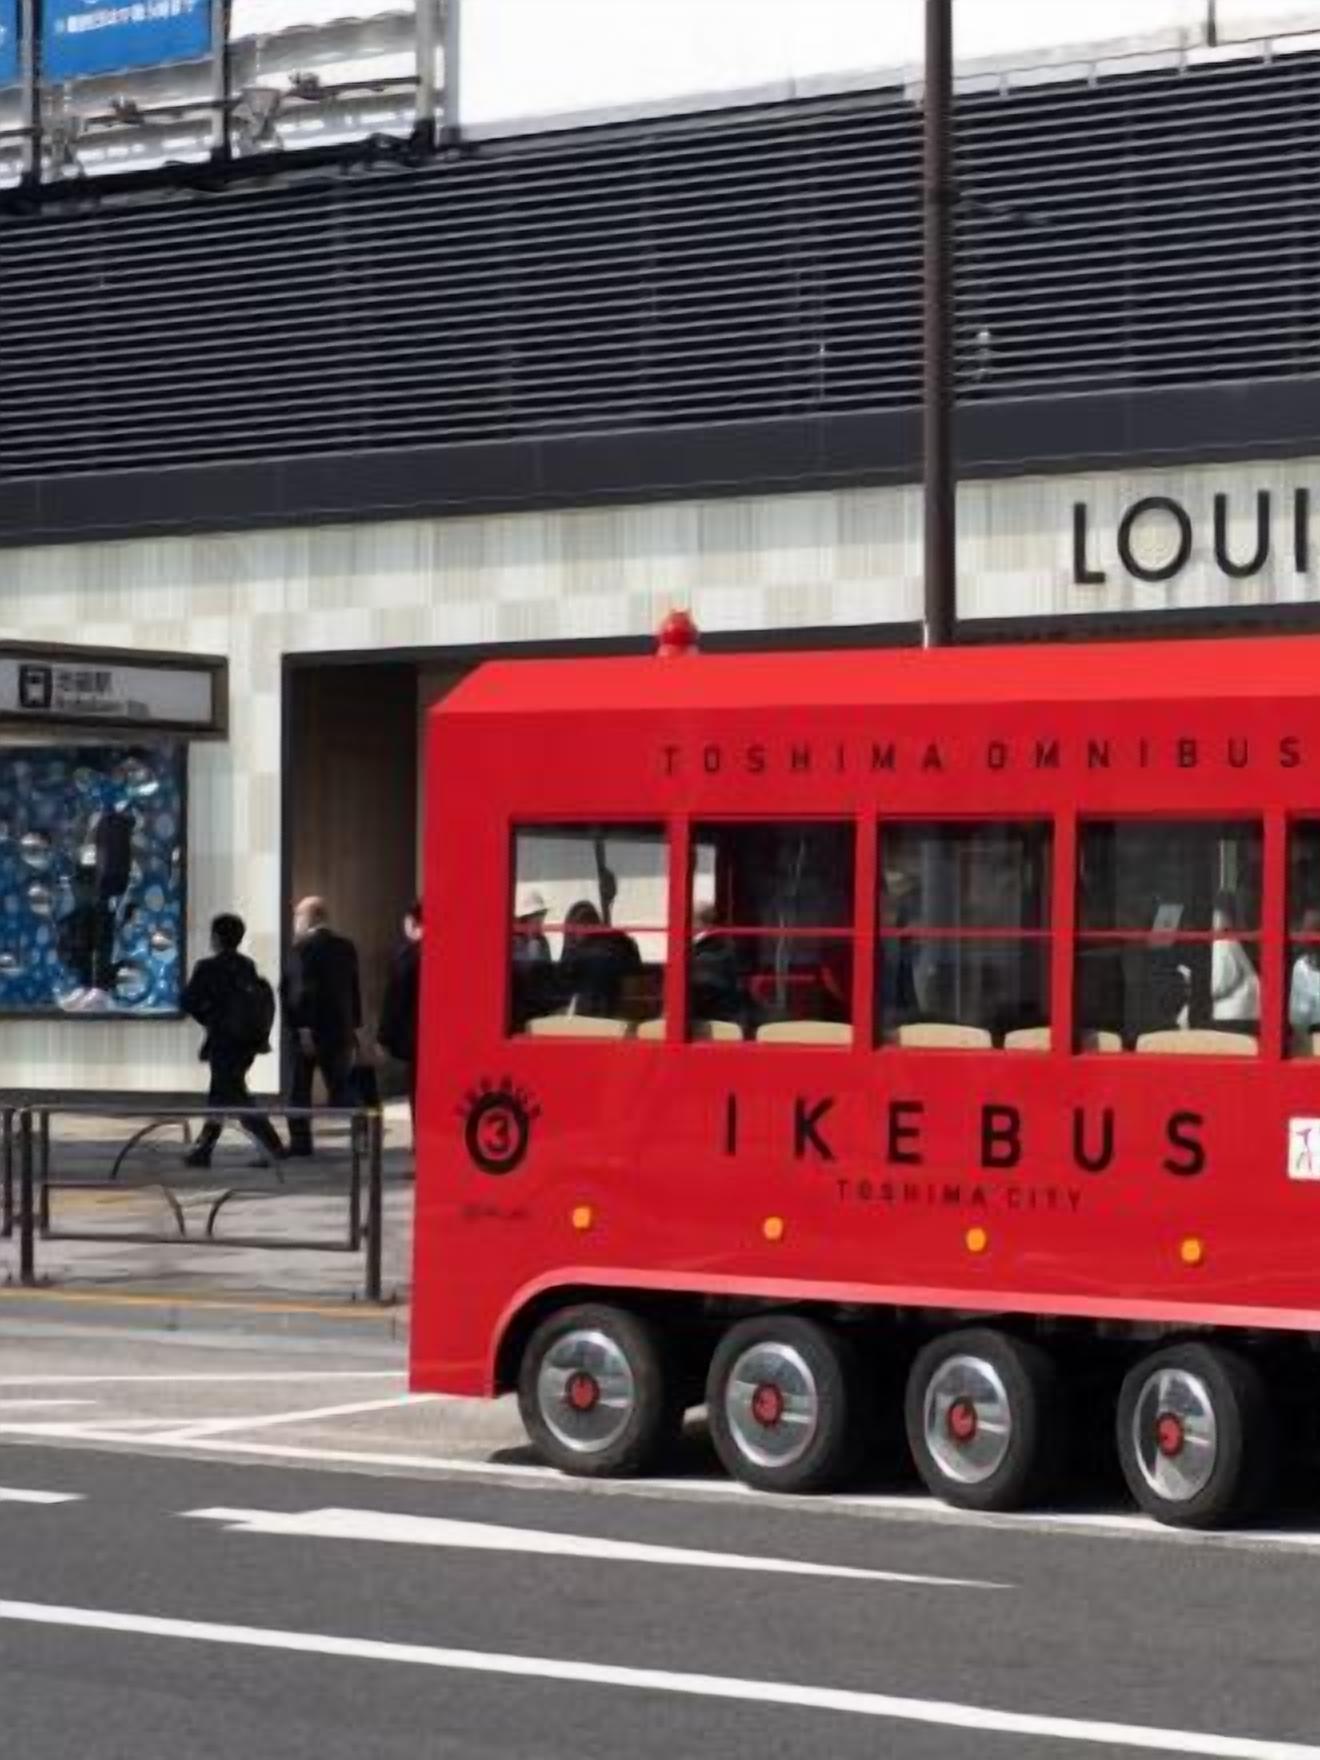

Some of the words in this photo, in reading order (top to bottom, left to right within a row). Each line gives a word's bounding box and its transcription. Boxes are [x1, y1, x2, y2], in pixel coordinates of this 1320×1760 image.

[662, 743, 944, 775] TOSHIMA
[986, 736, 1302, 771] OMNIBUS
[484, 1112, 512, 1153] 3
[723, 1092, 1209, 1179] IKEBUS
[837, 1178, 992, 1208] TOSHIMA
[1007, 1186, 1082, 1212] CITY
